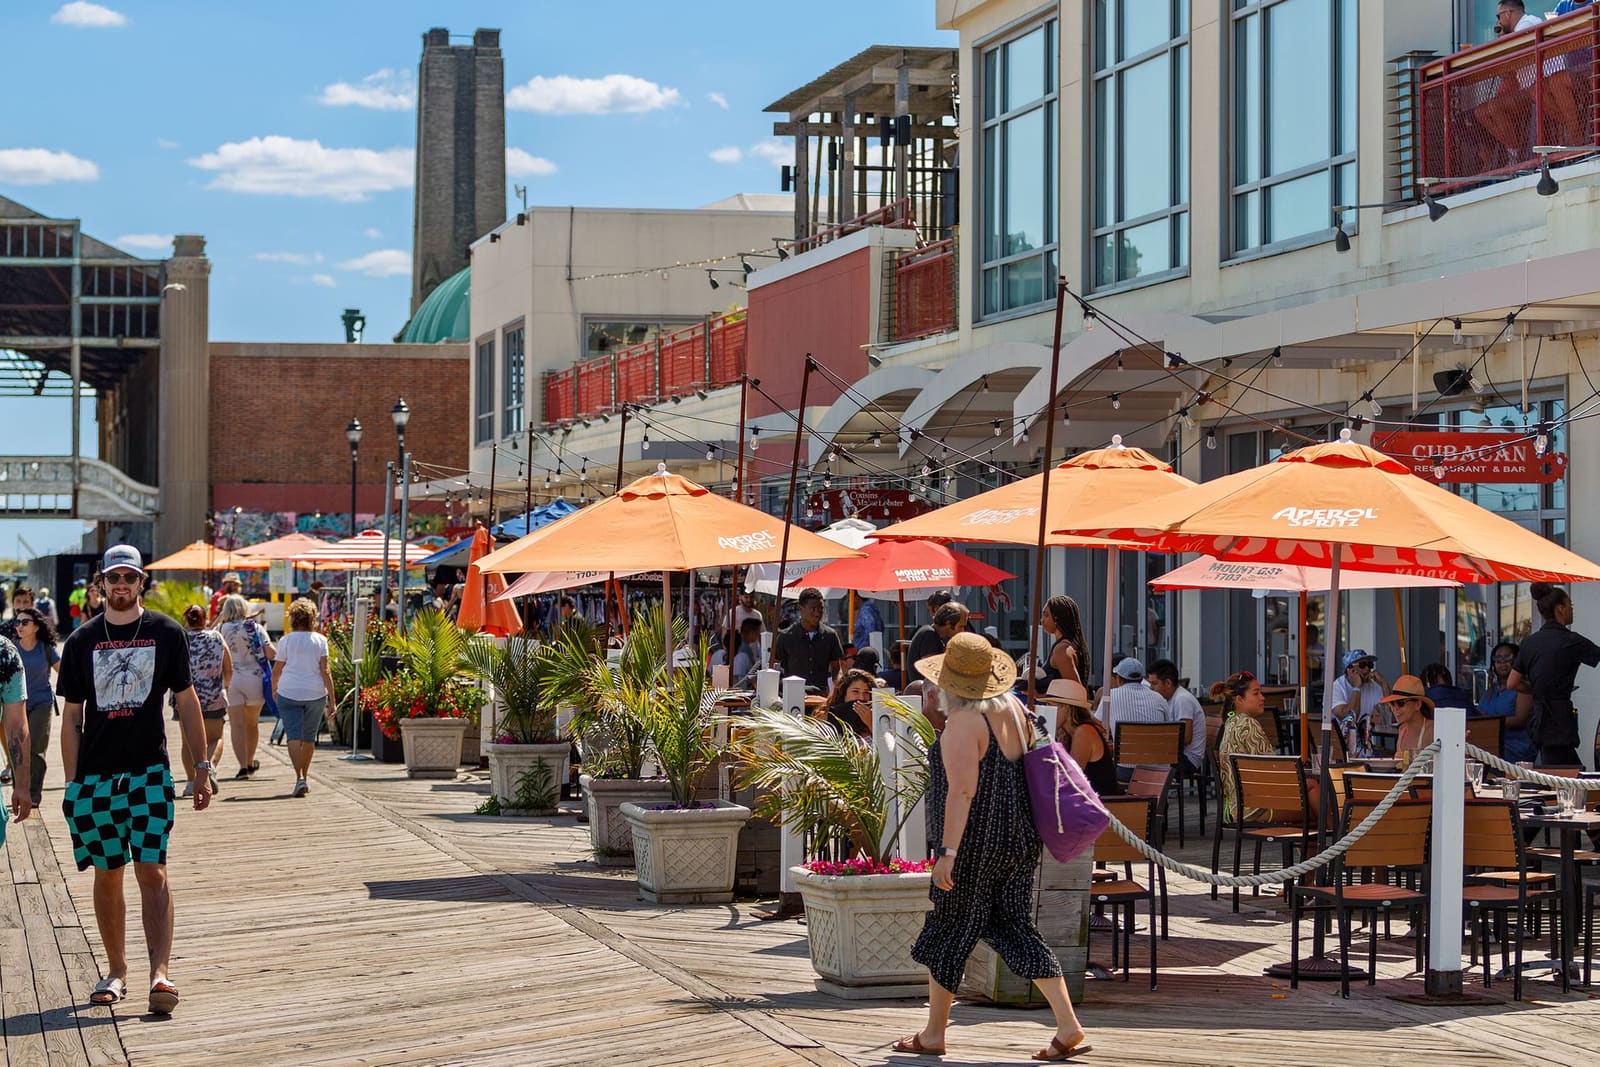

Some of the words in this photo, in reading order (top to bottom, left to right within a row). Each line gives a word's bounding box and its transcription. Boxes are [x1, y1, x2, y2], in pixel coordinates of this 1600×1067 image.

[1414, 465, 1487, 473] RESAURANT
[1492, 465, 1501, 473] &
[1503, 465, 1527, 473] BAR
[849, 490, 879, 501] Cousins
[1271, 506, 1379, 521] APEROL
[1287, 518, 1361, 528] SPRITZ
[717, 529, 777, 549] APEROL
[735, 540, 777, 553] SPRITZ
[894, 568, 929, 577] MOUNT
[1208, 562, 1254, 575] MOUNT
[575, 570, 598, 580] 1703
[1214, 573, 1242, 582] 1703
[94, 640, 125, 650] ATTACK
